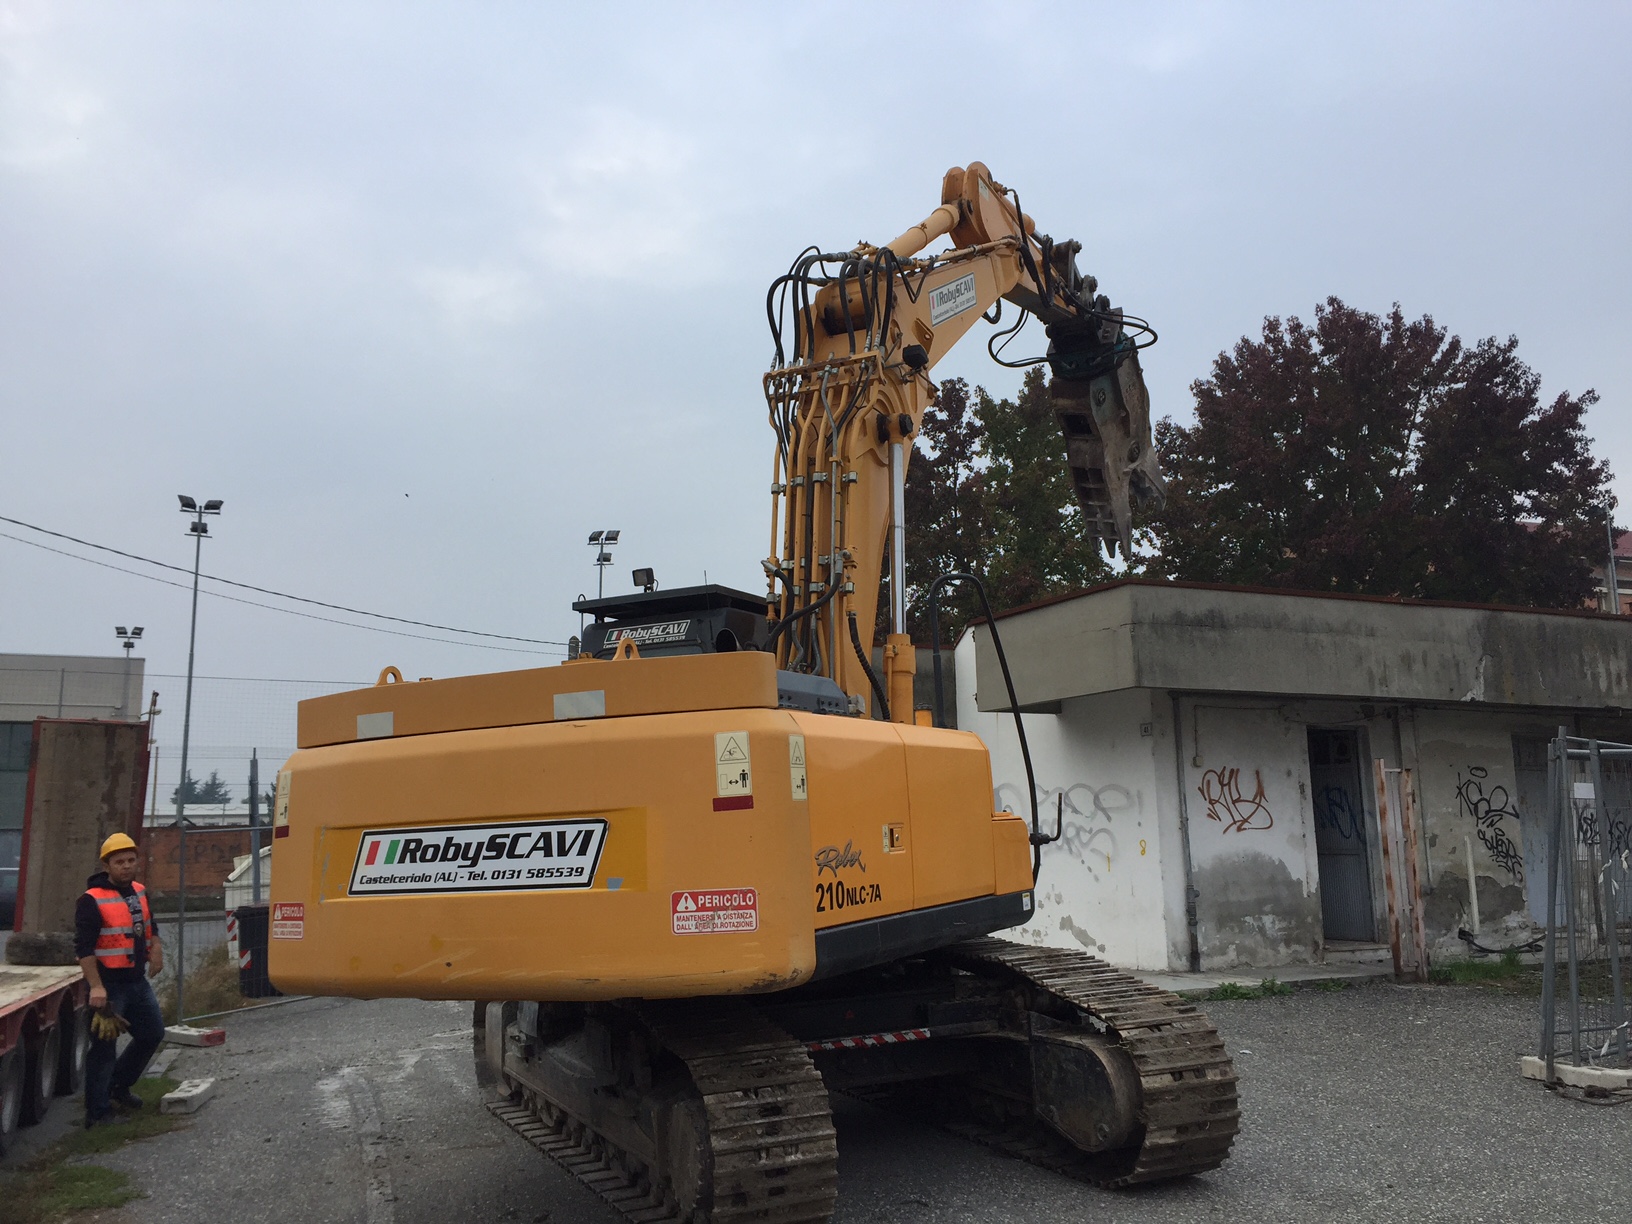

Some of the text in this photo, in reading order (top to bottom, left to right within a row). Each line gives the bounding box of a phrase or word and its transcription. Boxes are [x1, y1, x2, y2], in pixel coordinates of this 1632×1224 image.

[939, 277, 974, 306] RobySCAVI
[620, 622, 687, 639] RobySCAVI
[397, 829, 596, 869] RobySCAVI
[815, 838, 866, 877] Robex
[359, 873, 431, 885] Castelceriolo
[434, 871, 457, 884] (AL)
[467, 870, 487, 881] Tel.
[491, 869, 522, 880] 0131
[525, 866, 584, 879] 585539
[698, 893, 754, 907] PERICOLO
[723, 912, 753, 920] DISTANZA
[676, 923, 693, 931] DALL'
[719, 920, 754, 929] ROTAZIONE
